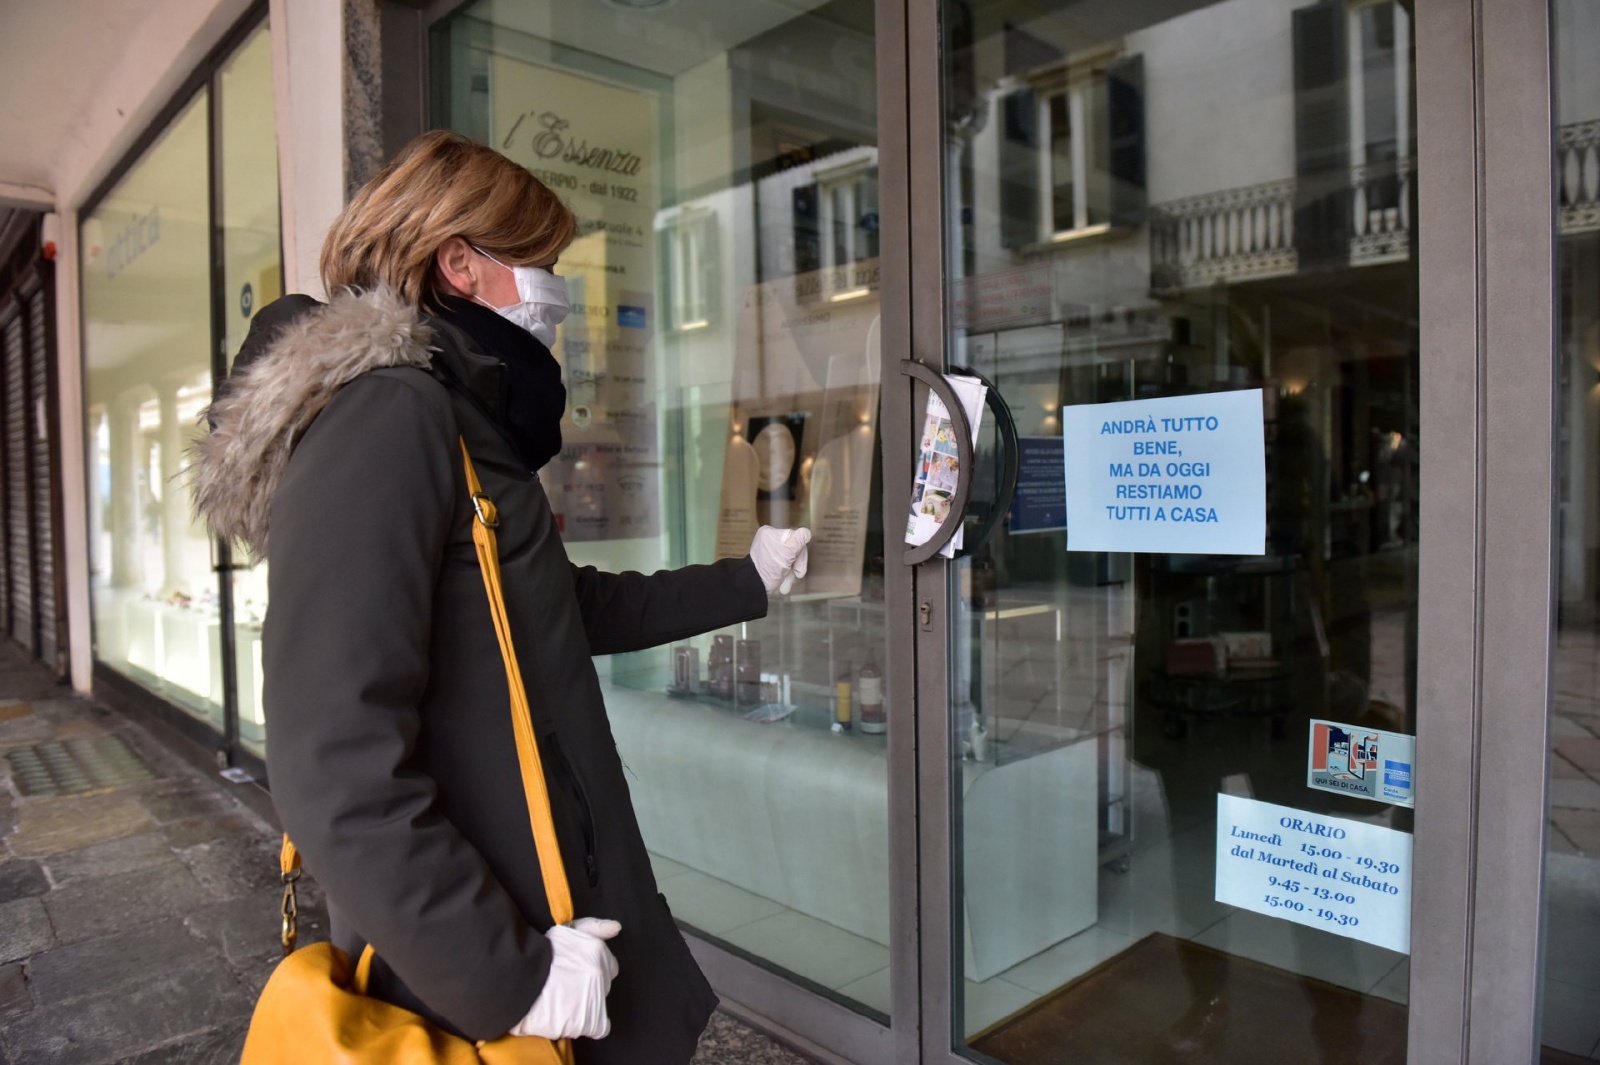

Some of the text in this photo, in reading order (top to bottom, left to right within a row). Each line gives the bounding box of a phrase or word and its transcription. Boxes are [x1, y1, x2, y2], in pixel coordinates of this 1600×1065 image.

[589, 181, 607, 195] dal
[610, 184, 639, 202] 1922
[1100, 415, 1218, 435] ANDRÀ TUTTO
[1133, 441, 1182, 457] BENE,
[1109, 462, 1210, 477] MA DA OGGI
[1116, 485, 1202, 500] RESTIAMO
[1106, 506, 1218, 522] TUTTI A CASA
[1279, 817, 1346, 840] ORARIO
[1230, 825, 1283, 846] Lunedì
[1300, 843, 1342, 860] 15.00
[1356, 856, 1400, 874] 19.30
[1231, 845, 1399, 895] dal Martedì al Sabato
[1268, 876, 1300, 893] 9.45
[1313, 886, 1356, 905] 13.00
[1264, 894, 1304, 912] 15.00
[1316, 908, 1359, 926] 19.30
